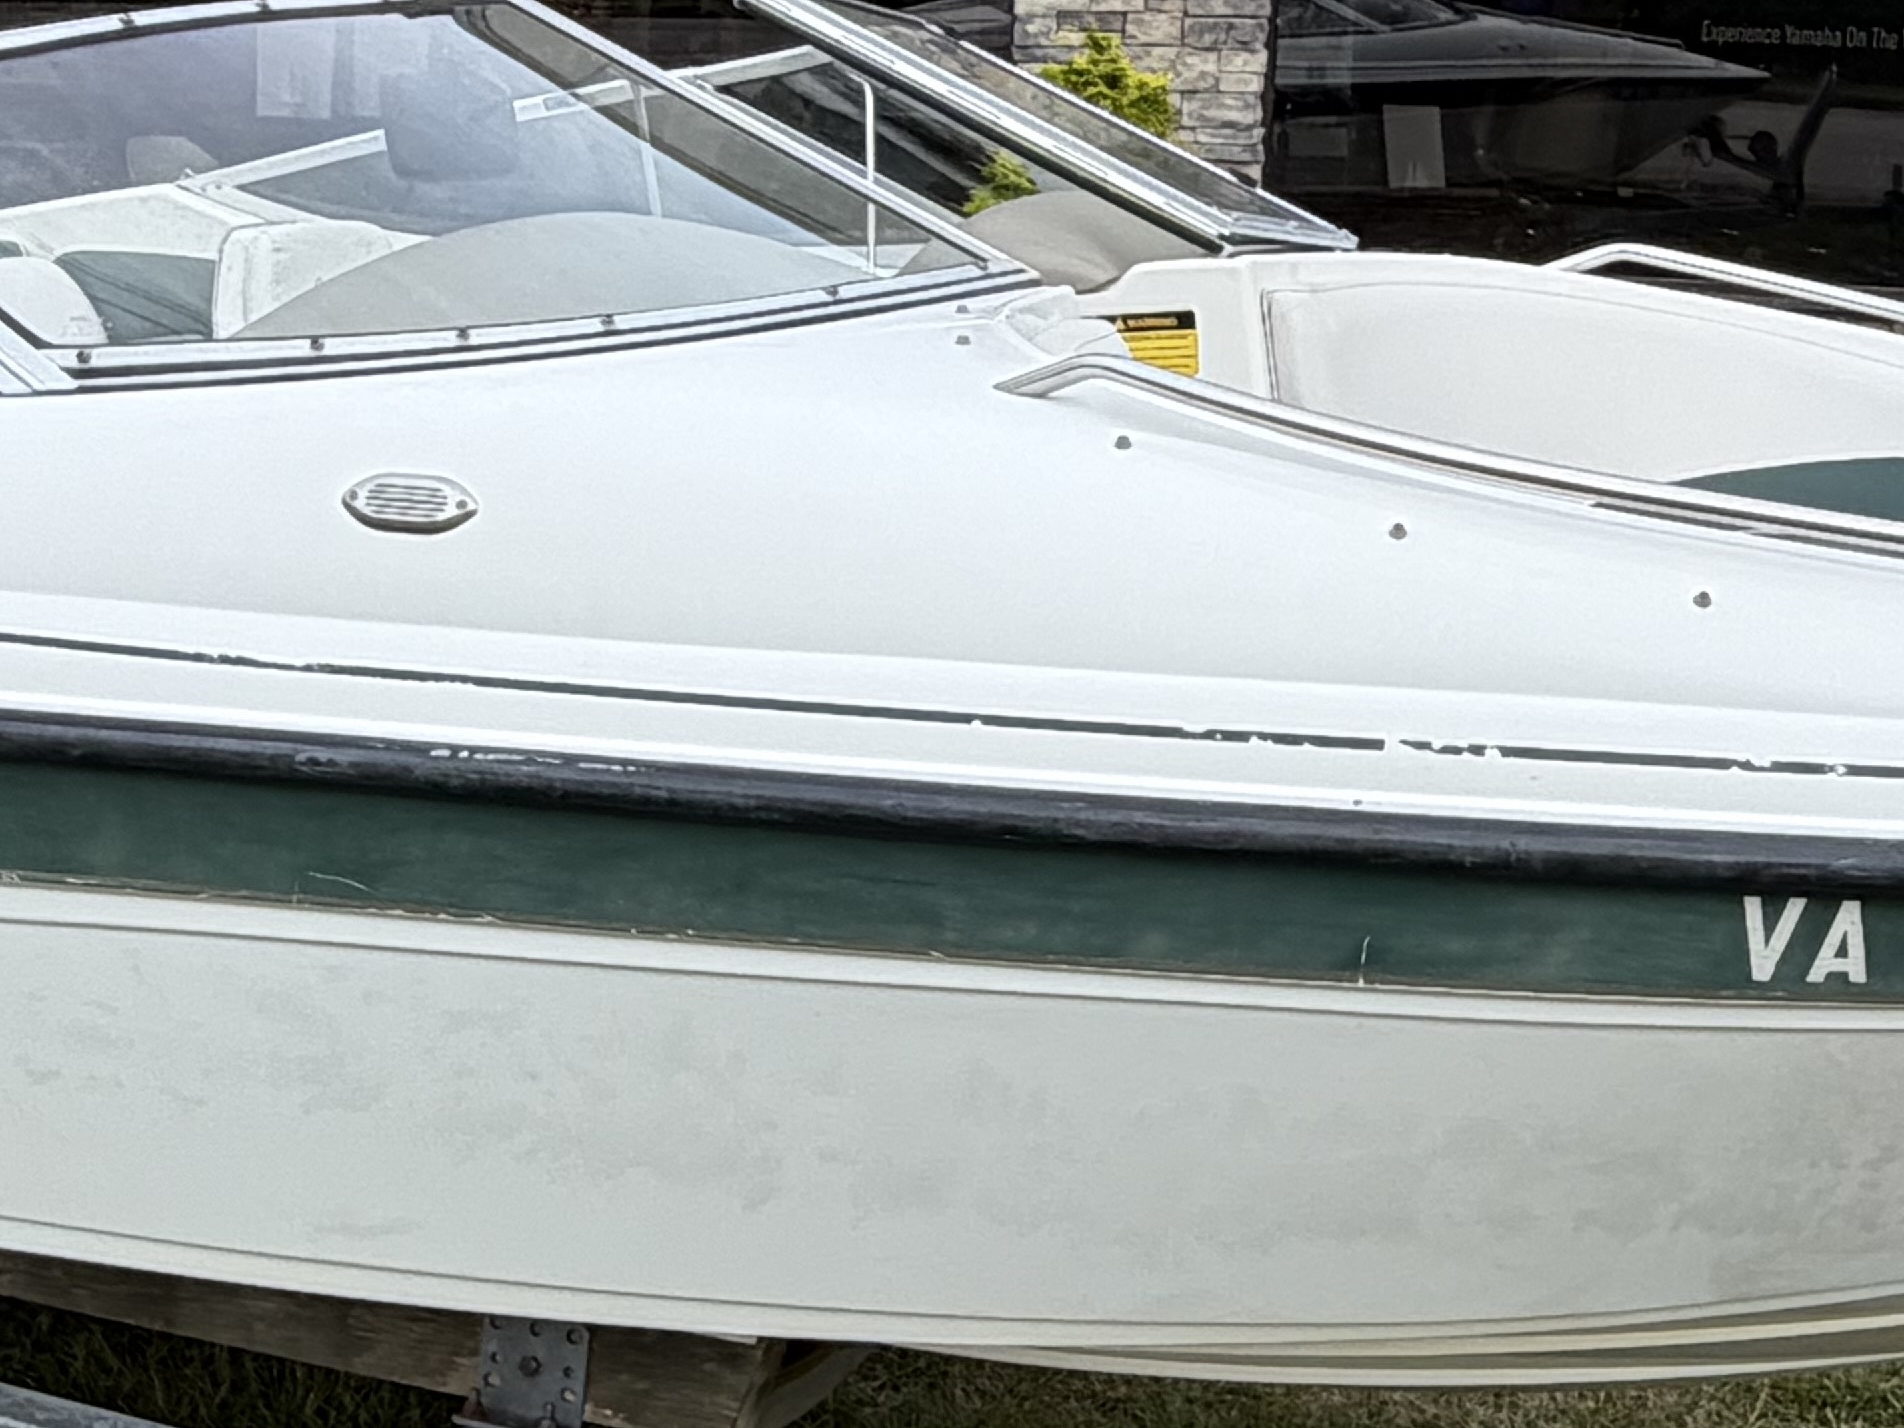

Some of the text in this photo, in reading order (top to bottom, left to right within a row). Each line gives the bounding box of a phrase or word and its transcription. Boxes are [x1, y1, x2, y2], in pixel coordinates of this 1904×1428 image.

[1700, 19, 1782, 48] Experience
[1785, 24, 1843, 49] Yamaha
[1846, 26, 1868, 49] On
[1871, 26, 1900, 50] The
[1742, 894, 1868, 986] VA
